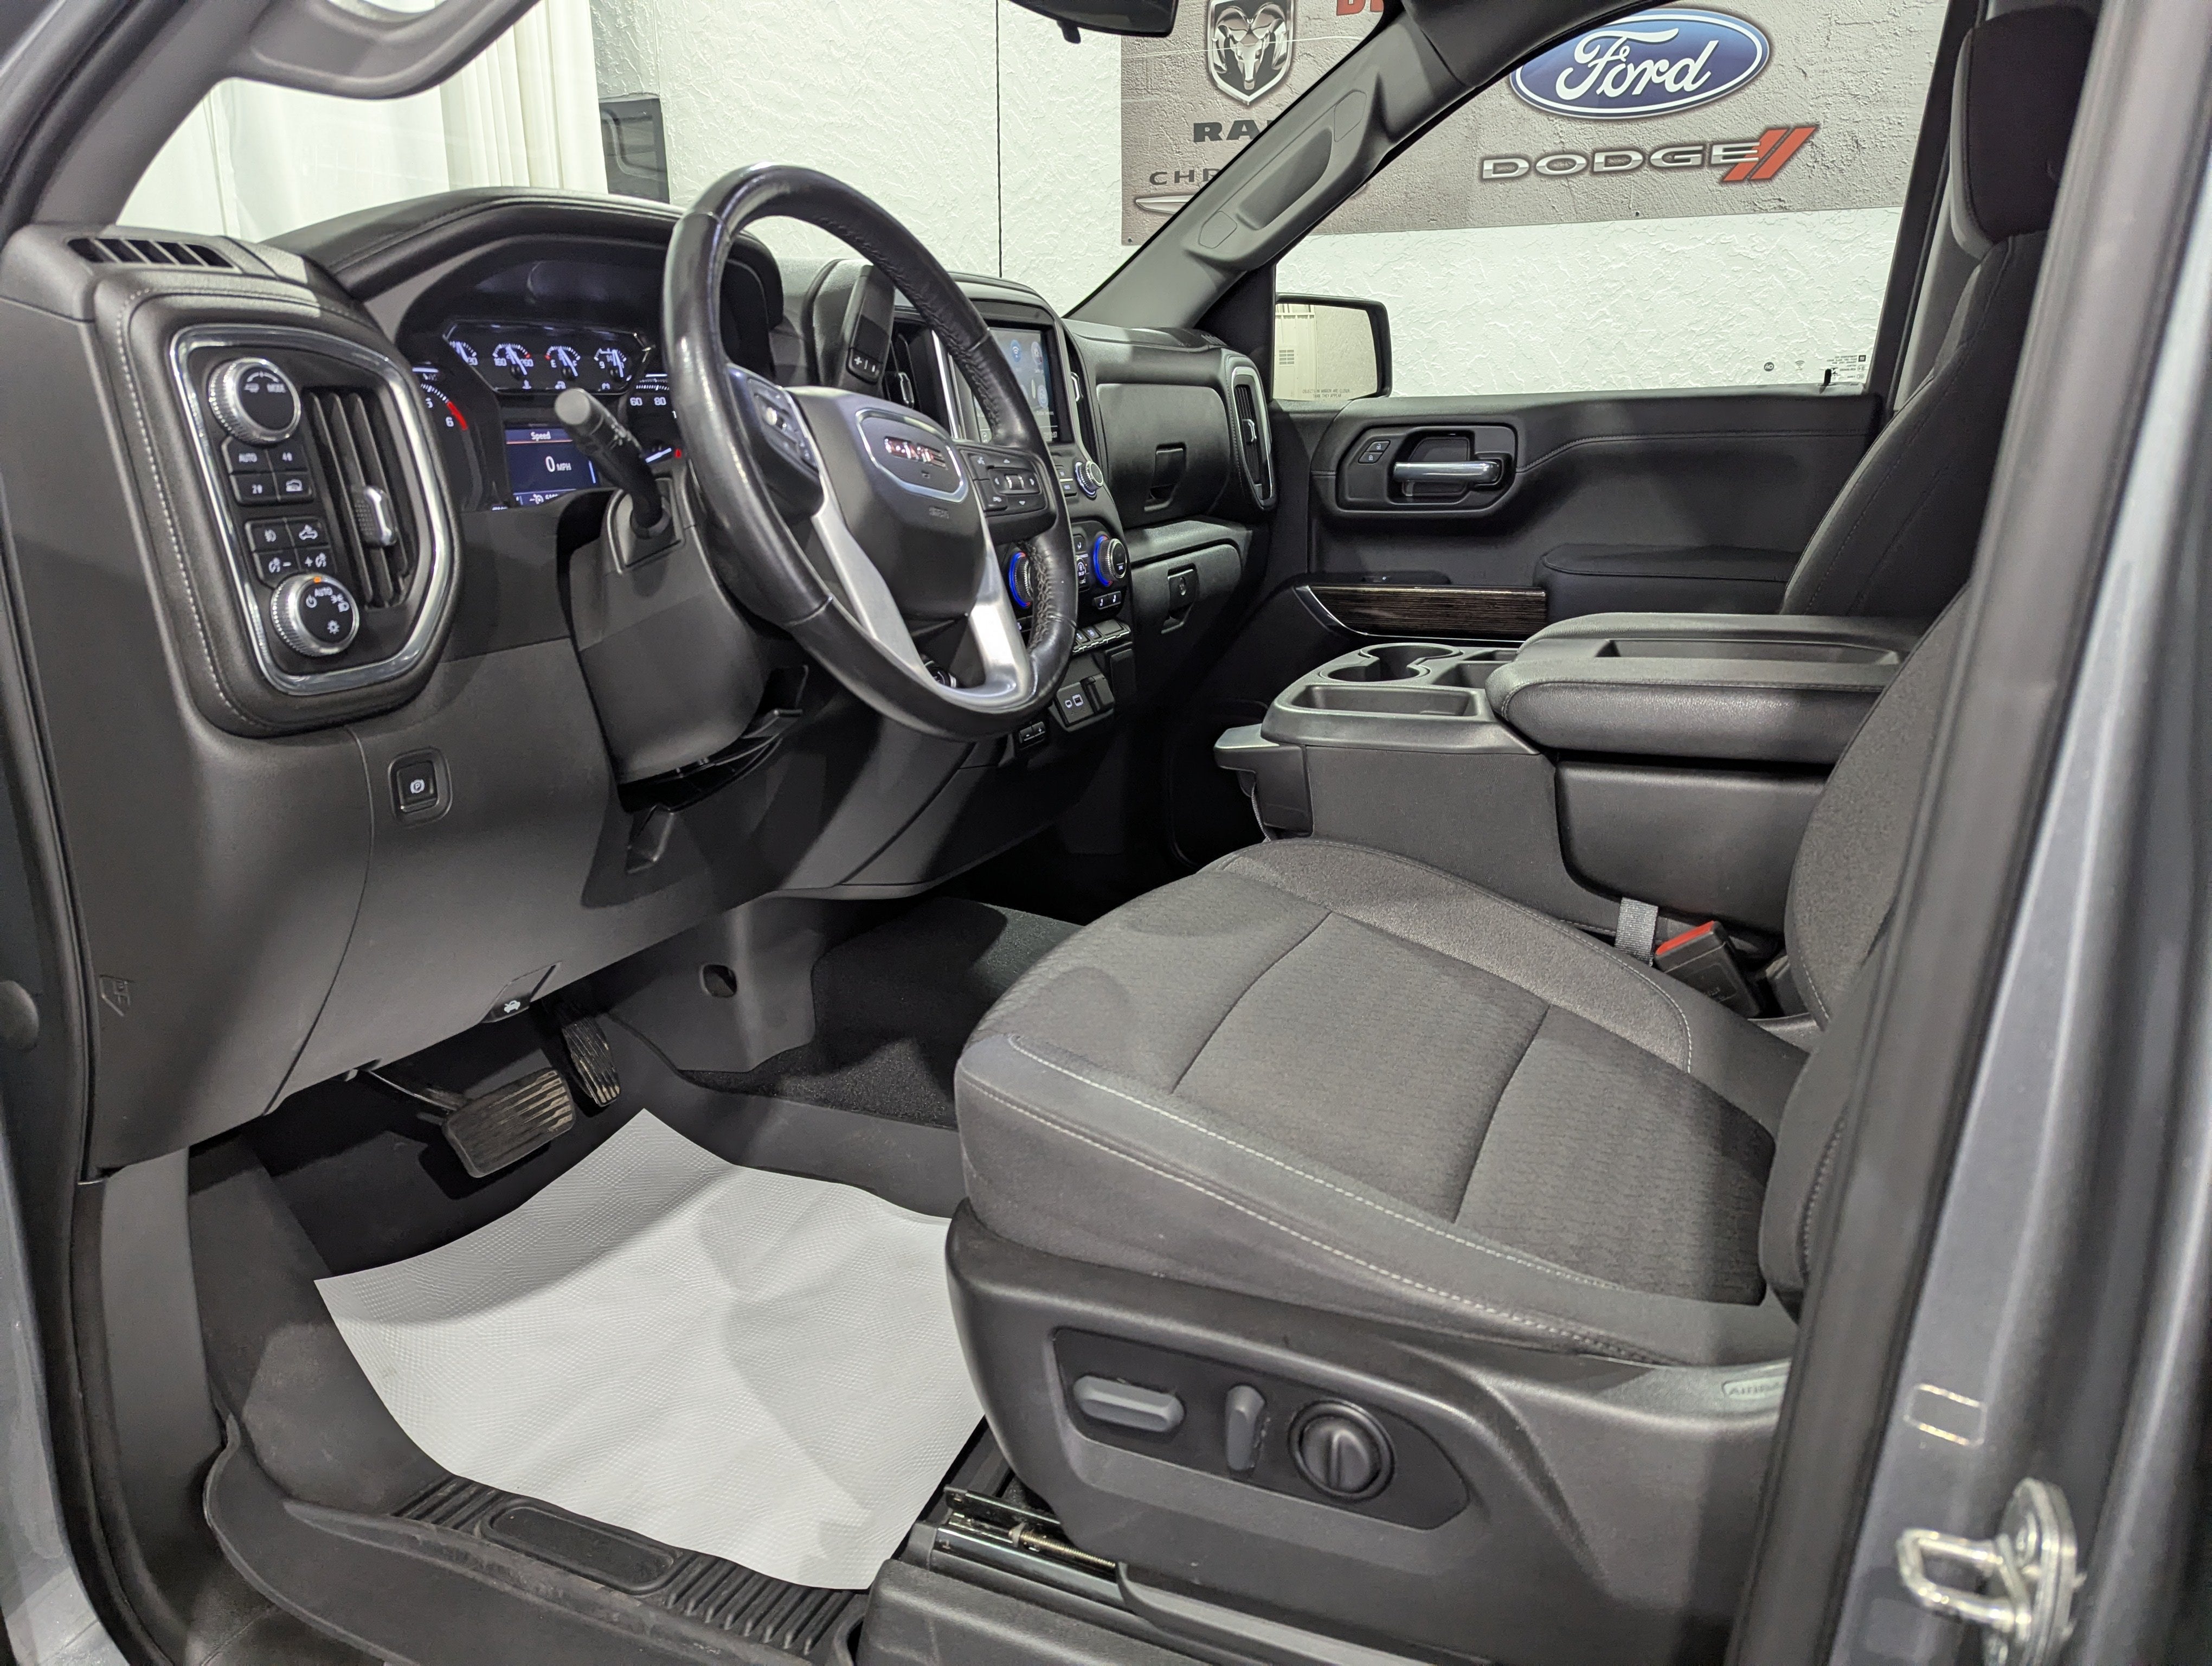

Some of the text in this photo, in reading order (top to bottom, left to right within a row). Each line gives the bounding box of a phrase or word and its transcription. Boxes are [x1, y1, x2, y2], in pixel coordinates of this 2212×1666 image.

[1555, 28, 1719, 100] Ford
[1193, 119, 1275, 143] RA
[1482, 142, 1761, 180] DODGE
[630, 397, 666, 406] 60 80
[446, 416, 454, 427] 6
[530, 431, 551, 441] Speed
[545, 456, 571, 472] 0 MPH
[314, 587, 333, 597] AUTO
